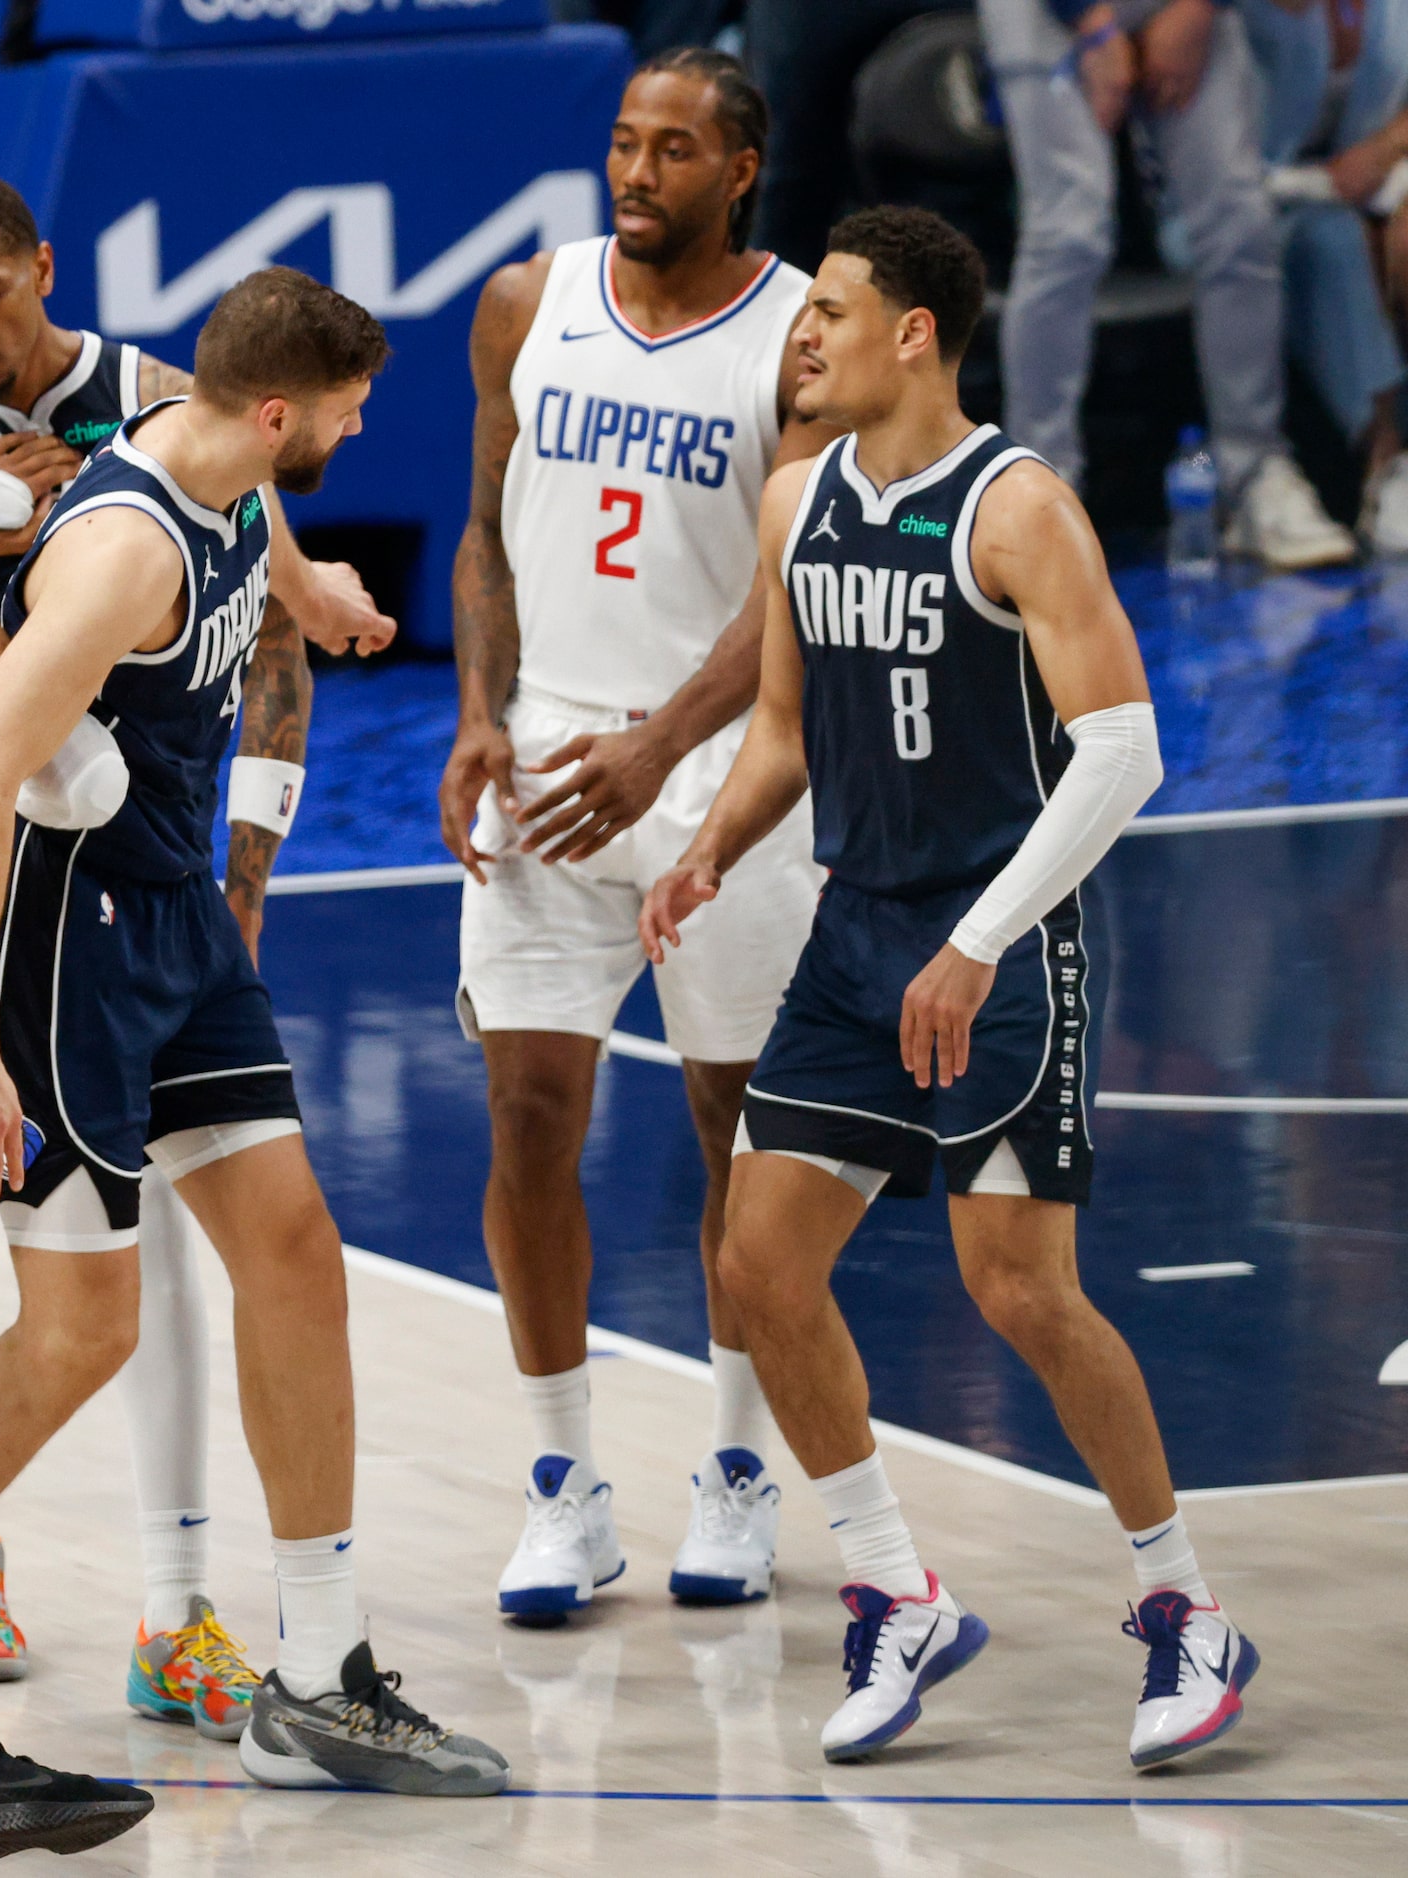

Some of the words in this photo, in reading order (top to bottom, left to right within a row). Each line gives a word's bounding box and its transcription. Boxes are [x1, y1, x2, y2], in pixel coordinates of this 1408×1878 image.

[535, 384, 736, 490] CLIPPERS
[594, 486, 643, 580] 2
[899, 513, 949, 538] chime
[792, 562, 947, 655] MAVS
[219, 637, 259, 730] 4
[890, 667, 933, 761] 8
[1057, 941, 1080, 1169] MAVERICKS
